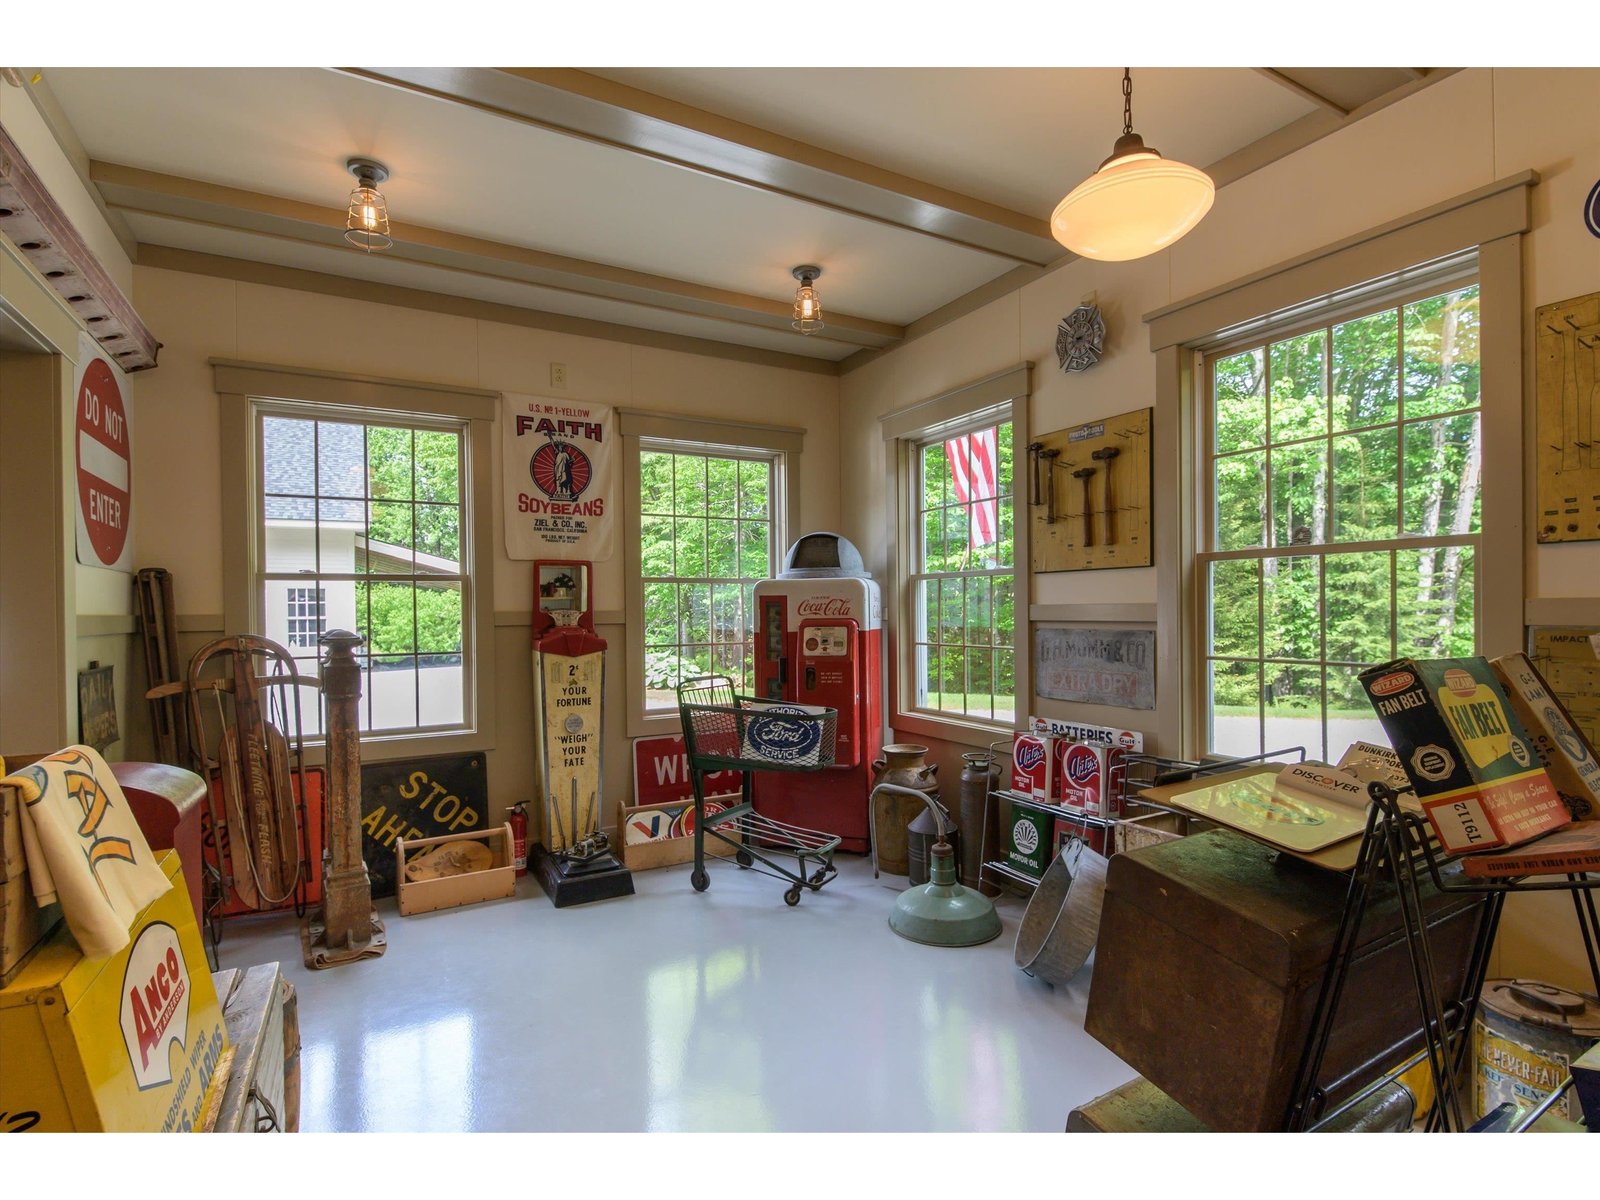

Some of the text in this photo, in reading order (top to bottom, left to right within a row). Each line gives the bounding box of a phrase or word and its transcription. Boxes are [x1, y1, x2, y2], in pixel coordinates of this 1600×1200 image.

[84, 388, 123, 444] DO NOT
[528, 403, 542, 414] U.S.
[516, 415, 602, 443] FAITH
[89, 489, 121, 530] ENTER
[518, 493, 604, 517] SOYBEANS
[534, 519, 549, 527] ZIEL
[552, 519, 559, 528] &
[575, 521, 587, 529] INC.
[797, 599, 851, 616] Coca-Cola
[1550, 635, 1589, 643] IMPACT
[562, 686, 587, 696] YOUR
[1372, 674, 1412, 693] WIZARD
[1449, 676, 1476, 690] WIZARD
[556, 697, 592, 708] FORTUNE
[1378, 688, 1428, 717] FAN BELT
[1448, 701, 1507, 741] FAN BELT
[761, 721, 804, 743] Ford
[1119, 737, 1135, 746] Gulf
[562, 746, 587, 756] YOUR
[759, 746, 799, 760] SERVICE
[1358, 744, 1398, 760] DUNKIRK
[564, 757, 585, 768] FATE
[1014, 775, 1030, 784] MOTOR
[1291, 768, 1361, 794] DISCOVER
[400, 771, 479, 832] STOP
[1065, 788, 1084, 797] MOTOR
[1454, 802, 1482, 843] T9112
[1009, 851, 1039, 869] MOTOR OIL
[130, 946, 180, 1073] ANCO
[155, 983, 185, 1040] BY ANDERSON
[189, 1030, 208, 1070] WIPER
[191, 1023, 224, 1127] AND ARMS
